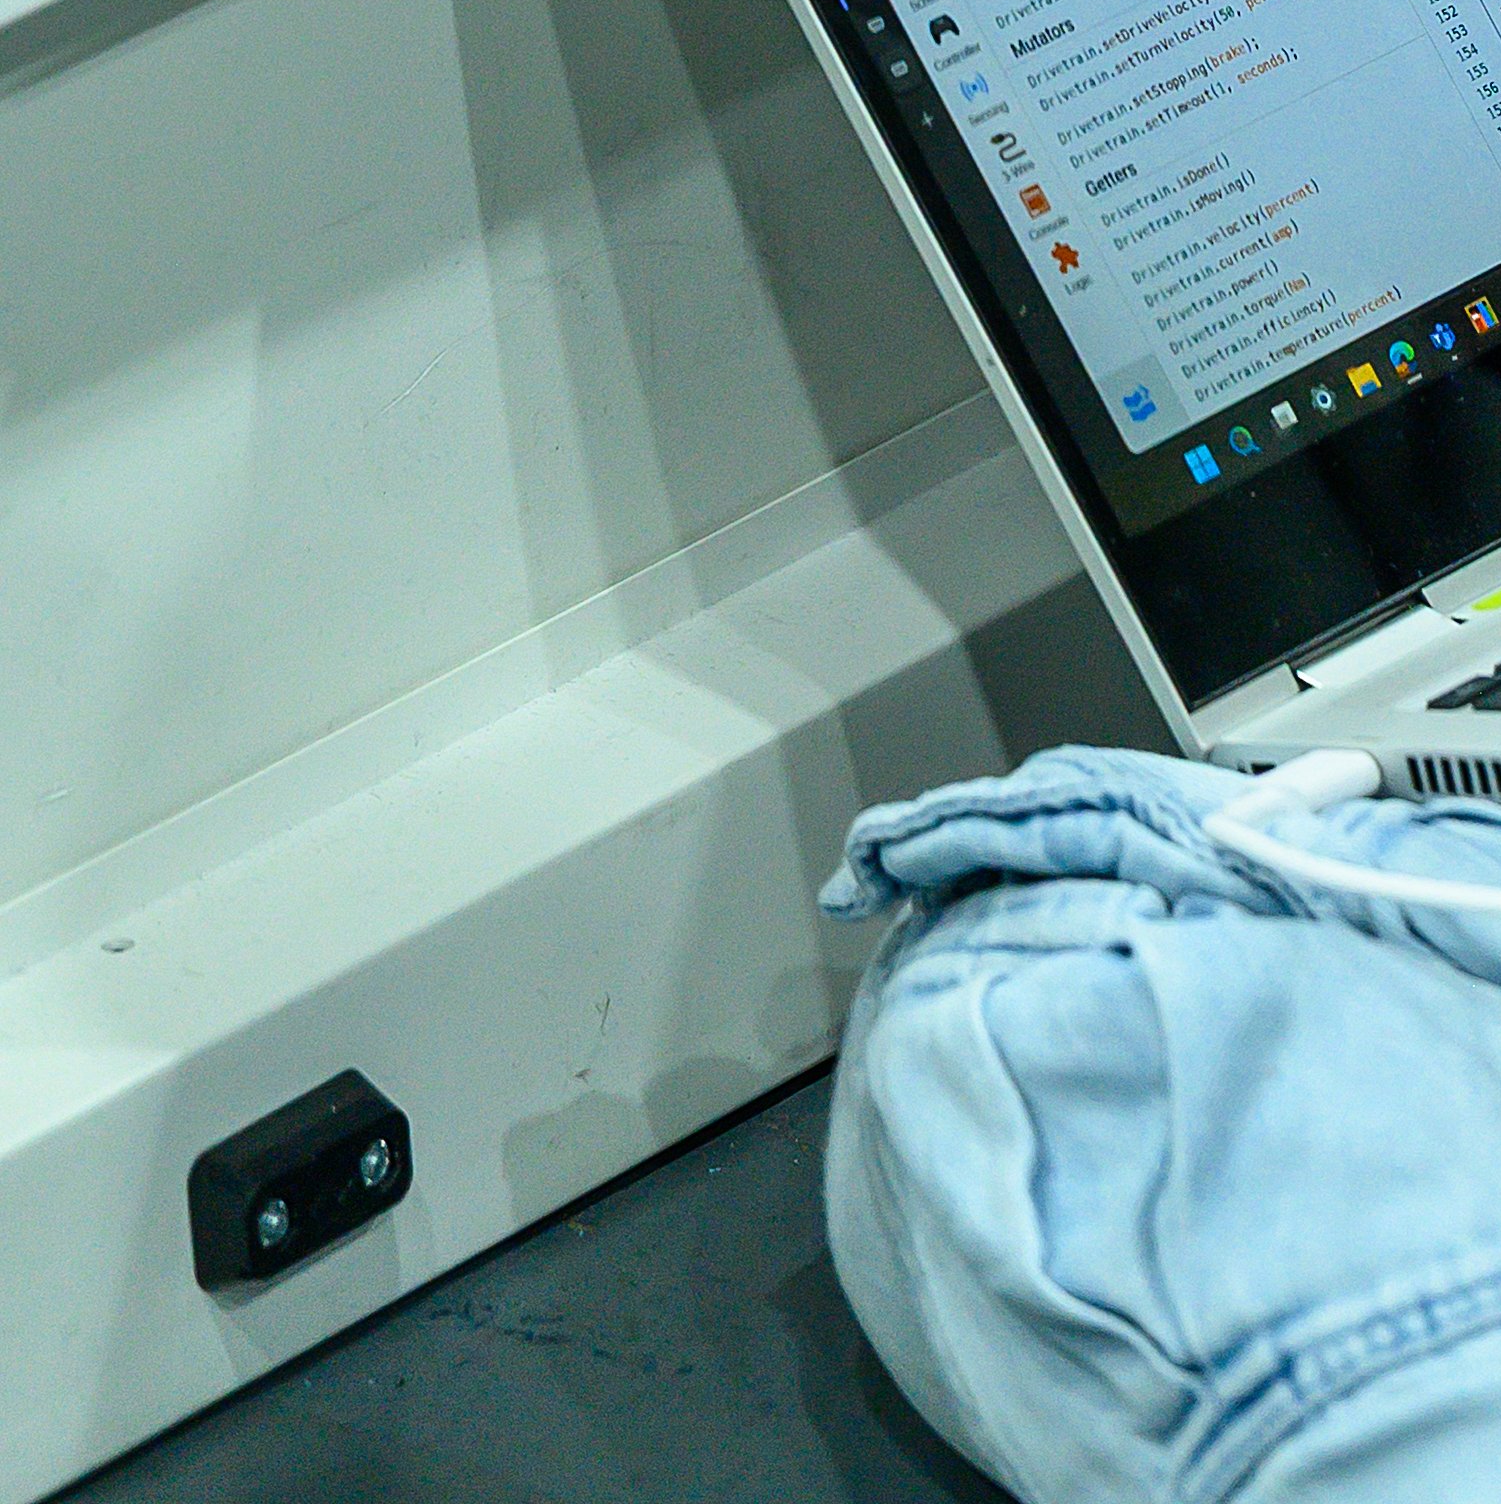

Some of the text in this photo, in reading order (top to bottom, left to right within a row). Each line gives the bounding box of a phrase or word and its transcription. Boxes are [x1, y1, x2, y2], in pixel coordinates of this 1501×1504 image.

[1009, 19, 1074, 58] Mutators
[1435, 4, 1458, 23] 152
[1445, 23, 1468, 43] 153
[1455, 42, 1478, 62] 154
[1039, 6, 1240, 111] Drivetrain.setTurnVelocity(50,
[1057, 38, 1258, 144] Drivetrain.setStopping(brake);
[1466, 61, 1488, 81] 155
[1476, 80, 1499, 100] 156
[1069, 47, 1298, 168] Drivetrain.setTimeout(1, seconds);
[1084, 163, 1137, 196] Getters
[1101, 152, 1229, 226] Drivetrain.isDone()
[1113, 169, 1255, 250] Drivetrain.isMoving()
[1131, 178, 1319, 284] Drivetrain.velocity(percent)
[1144, 219, 1298, 307] Drivetrain.current(amp)
[1156, 259, 1278, 331] Drivetrain.power()
[1169, 272, 1310, 354] Drivetrain.torque(Nm)
[1181, 289, 1336, 378] Drivetrain.efficiency()
[1194, 286, 1401, 401] Drivetrain.temperature(percent)
